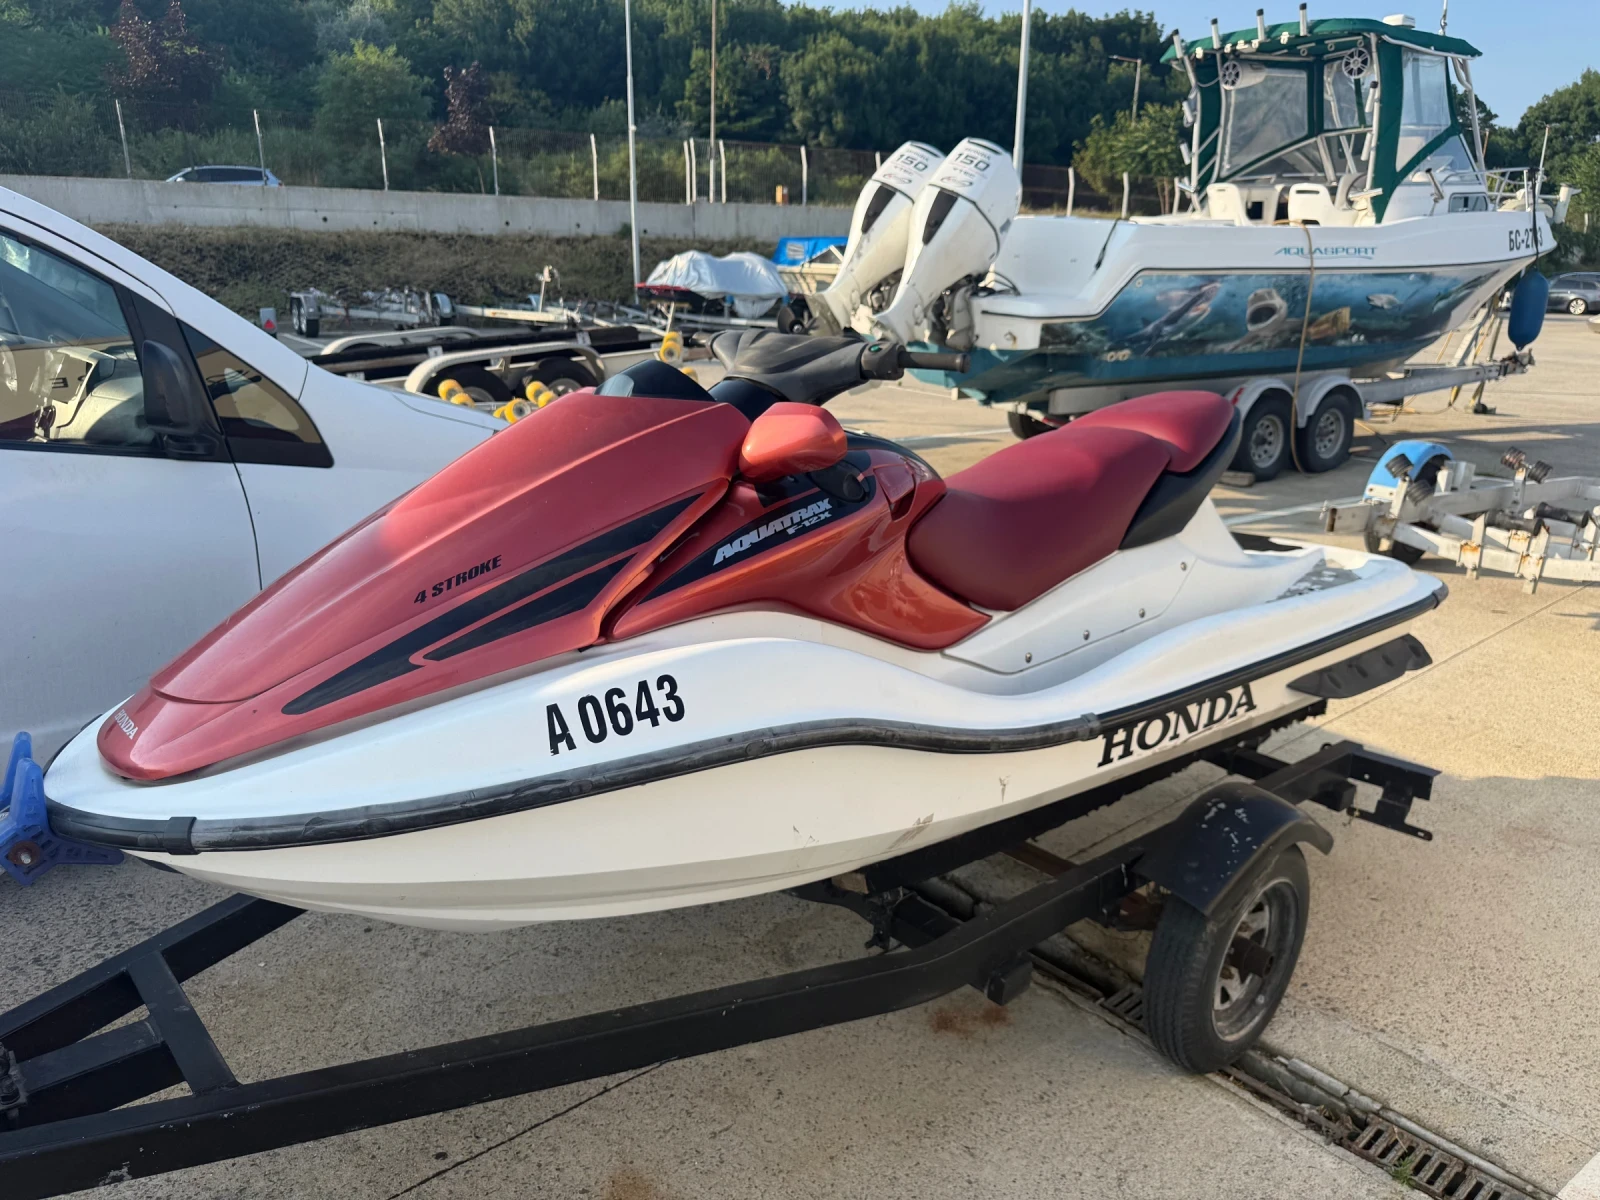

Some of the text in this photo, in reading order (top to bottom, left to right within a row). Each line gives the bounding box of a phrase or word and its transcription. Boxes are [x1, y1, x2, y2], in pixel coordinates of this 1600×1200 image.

[895, 154, 928, 172] 150
[953, 153, 990, 172] 150
[1274, 245, 1377, 256] AQUASPORT
[1508, 226, 1543, 252] БС-273
[713, 498, 832, 566] AQUATRAX
[786, 511, 832, 535] F-12X
[413, 554, 502, 604] 4 STROKE
[114, 708, 139, 740] HONDA
[546, 674, 685, 756] A 0643
[1097, 682, 1257, 768] HONDA
